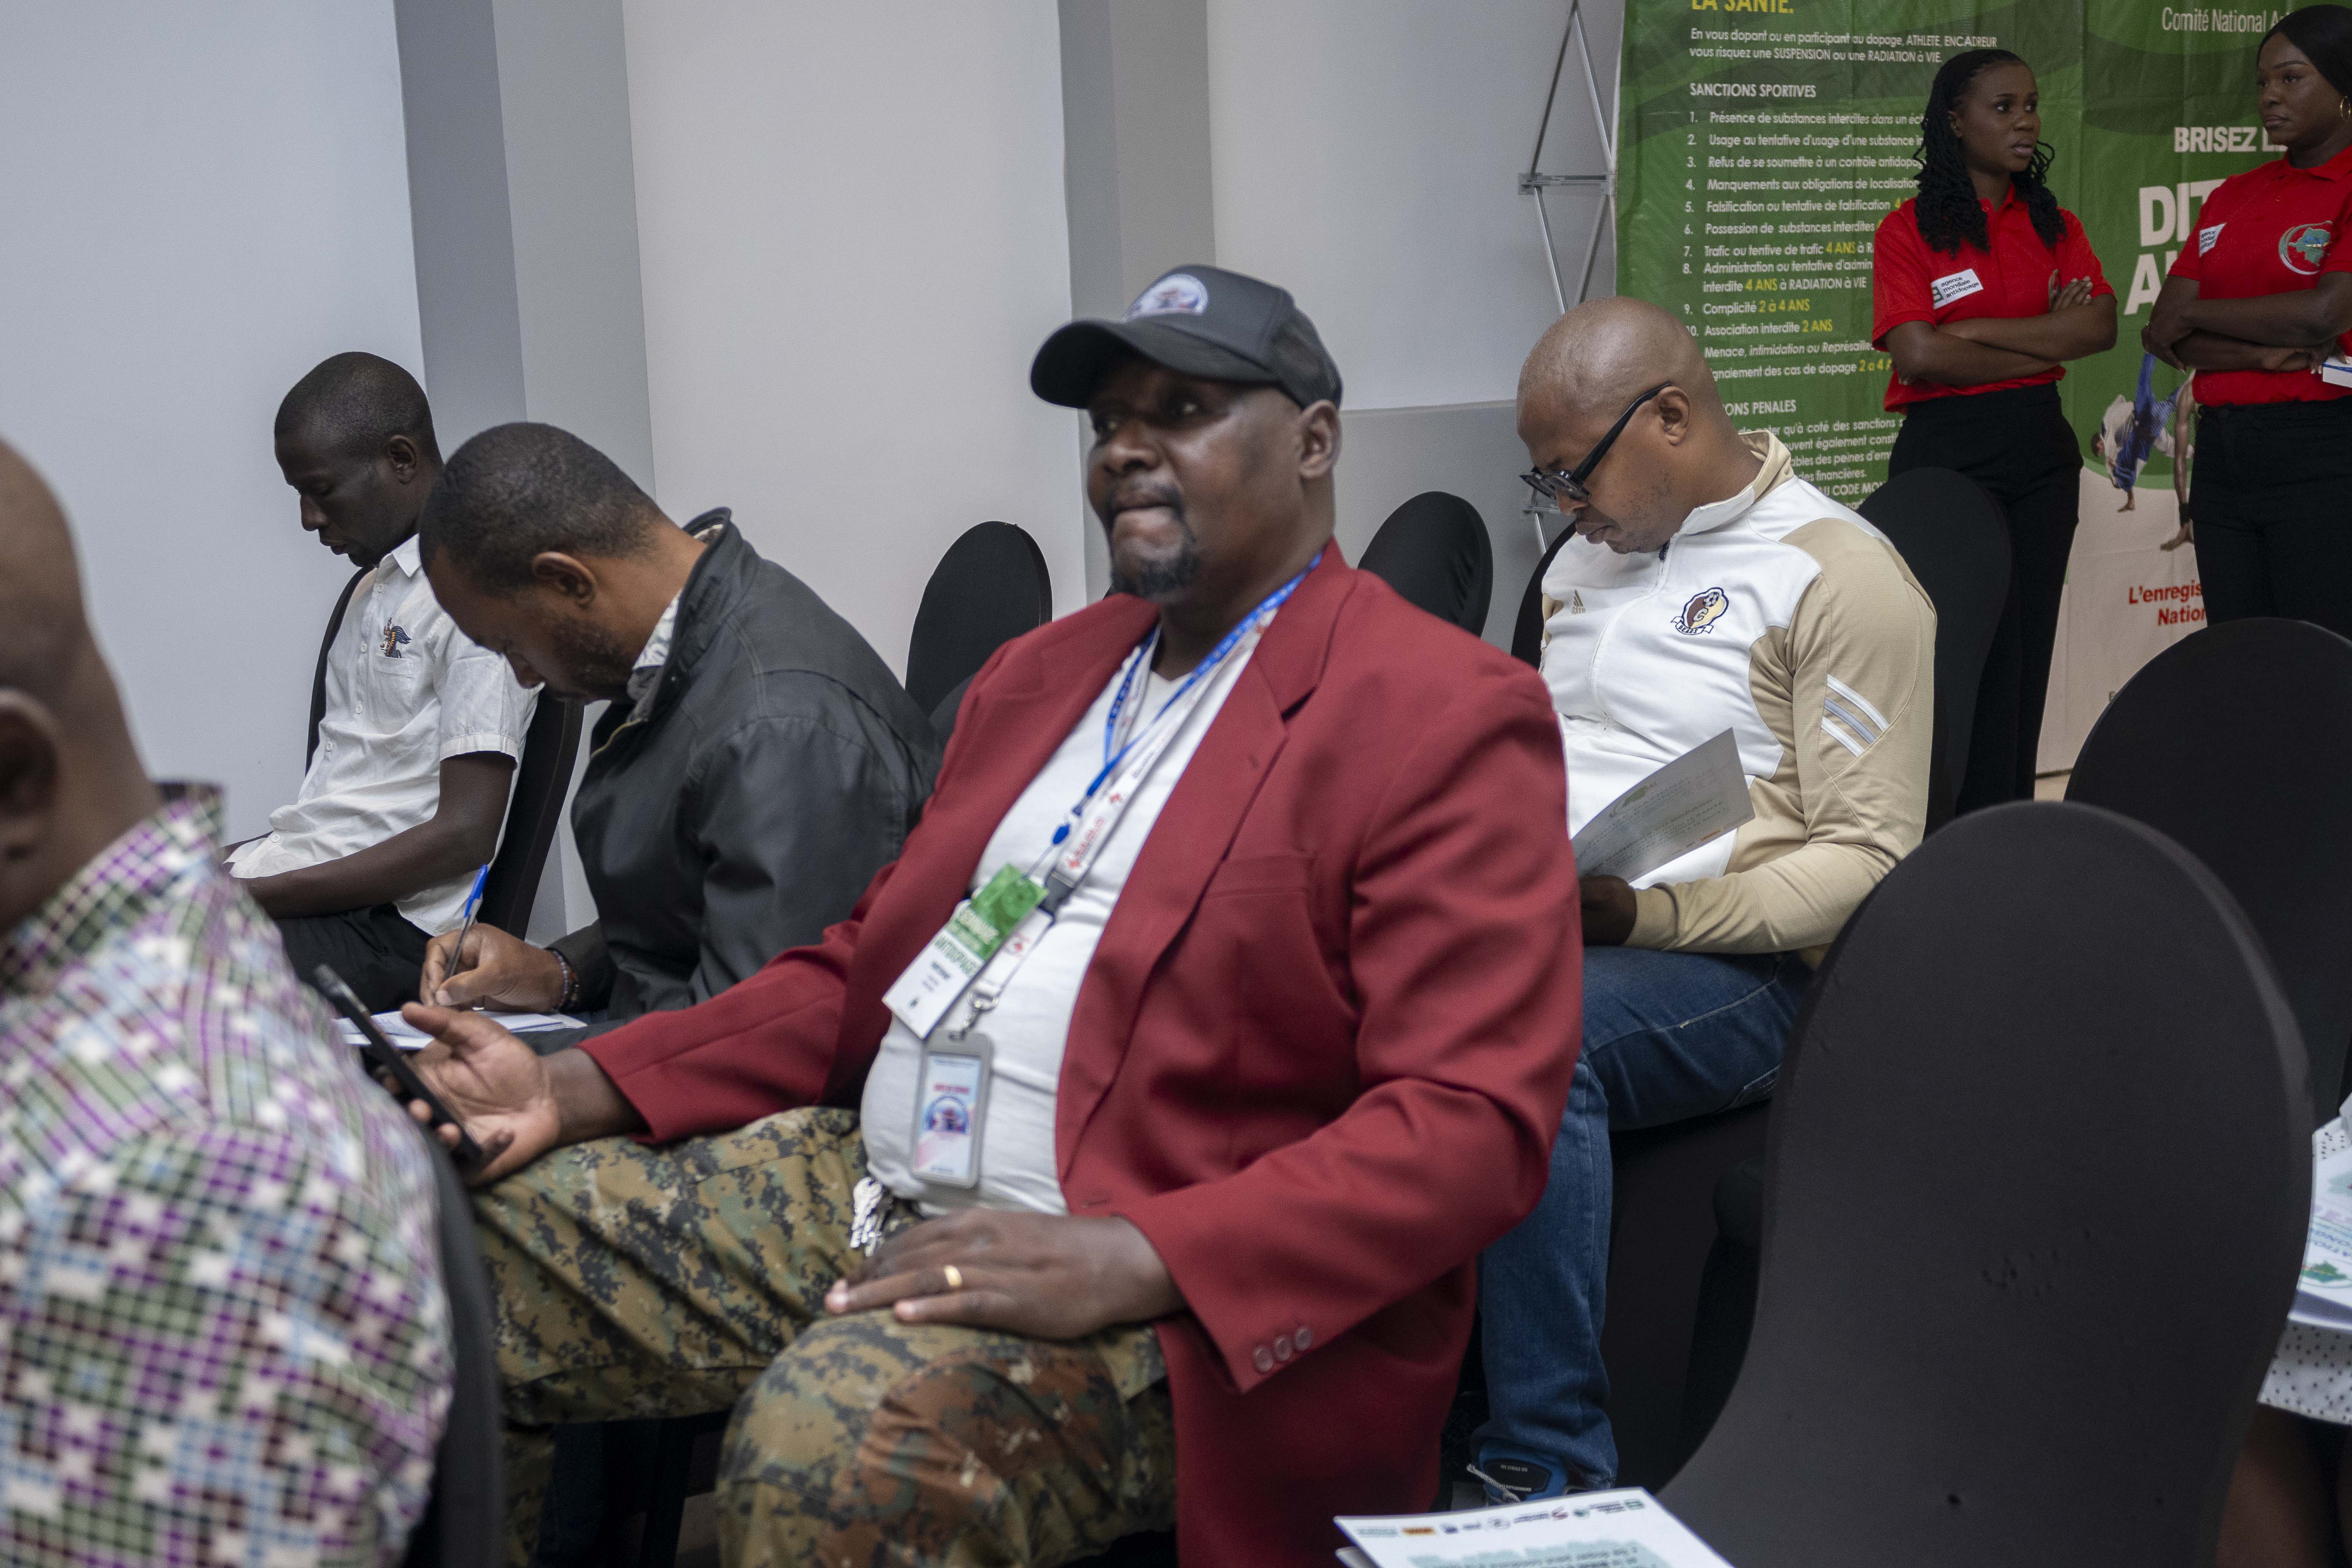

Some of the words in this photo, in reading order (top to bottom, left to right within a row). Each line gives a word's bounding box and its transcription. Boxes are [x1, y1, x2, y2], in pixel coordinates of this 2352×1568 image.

[2161, 7, 2209, 31] Comité
[2211, 8, 2267, 33] National
[1690, 27, 1703, 40] En
[1705, 30, 1729, 41] vous
[1731, 29, 1768, 43] dopant
[1769, 32, 1782, 42] ou
[1784, 33, 1796, 42] en
[1797, 32, 1851, 45] participant
[1944, 35, 1998, 48] ENCADREUR
[1689, 48, 1714, 57] vous
[1715, 46, 1751, 60] risquez
[1753, 49, 1772, 59] une
[1773, 47, 1831, 60] SUSPENSION
[1832, 52, 1846, 61] ou
[1848, 52, 1866, 61] une
[1867, 50, 1916, 63] RADIATION
[1917, 51, 1924, 63] à
[1689, 83, 1757, 98] SANCTIONS
[1759, 84, 1817, 98] SPORTIVES
[1690, 111, 1698, 123] 1.
[1710, 110, 1756, 123] Présence
[1757, 112, 1772, 123] de
[1773, 112, 1827, 124] substances
[1828, 112, 1870, 124] interdites
[1871, 113, 1894, 125] dans
[1895, 116, 1907, 125] un
[1688, 133, 1697, 146] 2.
[1709, 134, 1741, 148] Usage
[1757, 133, 1801, 146] tentative
[1802, 133, 1839, 148] d'usage
[1842, 134, 1867, 146] d'une
[1869, 134, 1915, 146] substance
[2173, 126, 2257, 153] BRISEZ
[2262, 127, 2288, 153] L
[1687, 156, 1696, 168] 3.
[1708, 155, 1734, 168] Refus
[1737, 156, 1751, 168] de
[1753, 158, 1765, 168] se
[1767, 155, 1814, 168] soumettre
[1816, 155, 1824, 168] à
[1825, 158, 1837, 168] un
[1838, 155, 1877, 168] contrôle
[1685, 178, 1695, 191] 4.
[1707, 178, 1780, 193] Manquements
[1782, 180, 1800, 190] aux
[1802, 178, 1854, 192] obligations
[1855, 178, 1868, 190] de
[1685, 201, 1694, 212] 5.
[1707, 200, 1765, 212] Falsification
[1767, 202, 1780, 212] ou
[1781, 199, 1823, 212] tentative
[1824, 200, 1838, 211] de
[1838, 199, 1891, 211] falsification
[1684, 223, 1693, 235] 6.
[1705, 222, 1759, 234] Possession
[1760, 222, 1775, 234] de
[1778, 221, 1832, 234] substances
[1833, 220, 1876, 233] interdites
[1684, 245, 1693, 257] 7.
[1704, 245, 1731, 257] Trafic
[1733, 247, 1747, 256] ou
[1784, 243, 1799, 255] de
[1799, 243, 1824, 255] trafic
[1826, 241, 1833, 253] 4
[1833, 241, 1856, 254] ANS
[1857, 240, 1865, 253] à
[1866, 241, 1874, 253] R
[1682, 262, 1692, 274] 8.
[1704, 261, 1775, 274] Administration
[1776, 263, 1790, 272] ou
[1791, 259, 1833, 272] tentative
[1703, 280, 1744, 293] interdite
[1745, 278, 1753, 291] 4
[1754, 278, 1778, 291] ANS
[1779, 278, 1787, 291] à
[1789, 277, 1842, 290] RADIATION
[1844, 276, 1852, 289] à
[1853, 277, 1867, 289] VIE
[1941, 276, 1963, 287] agence
[1943, 279, 1971, 293] mondiale
[1946, 282, 1980, 298] antidopage
[1683, 303, 1693, 315] 9.
[1702, 300, 1758, 316] Complicité
[1758, 299, 1767, 313] 2
[1768, 299, 1777, 313] à
[1778, 299, 1786, 312] 4
[1788, 298, 1811, 312] ANS
[1704, 323, 1760, 336] Association
[1760, 321, 1801, 334] interdite
[1802, 319, 1809, 333] 2
[1811, 318, 1834, 332] ANS
[1704, 347, 1747, 358] Menace,
[1749, 343, 1805, 356] intimidation
[1807, 344, 1820, 354] ou
[1764, 365, 1782, 376] des
[1783, 366, 1802, 376] cas
[1803, 363, 1816, 375] de
[1818, 362, 1857, 376] dopage
[1859, 359, 1866, 372] 2
[1877, 358, 1884, 371] 4
[1752, 399, 1797, 415] PENALES
[1807, 419, 1829, 433] coté
[1833, 420, 1850, 432] des
[1853, 418, 1896, 431] sanctions
[1816, 434, 1867, 452] également
[1816, 454, 1832, 466] des
[1834, 452, 1865, 466] peines
[1832, 483, 1860, 496] CODE
[1861, 481, 1884, 494] MO
[1678, 625, 1699, 634] BEARS
